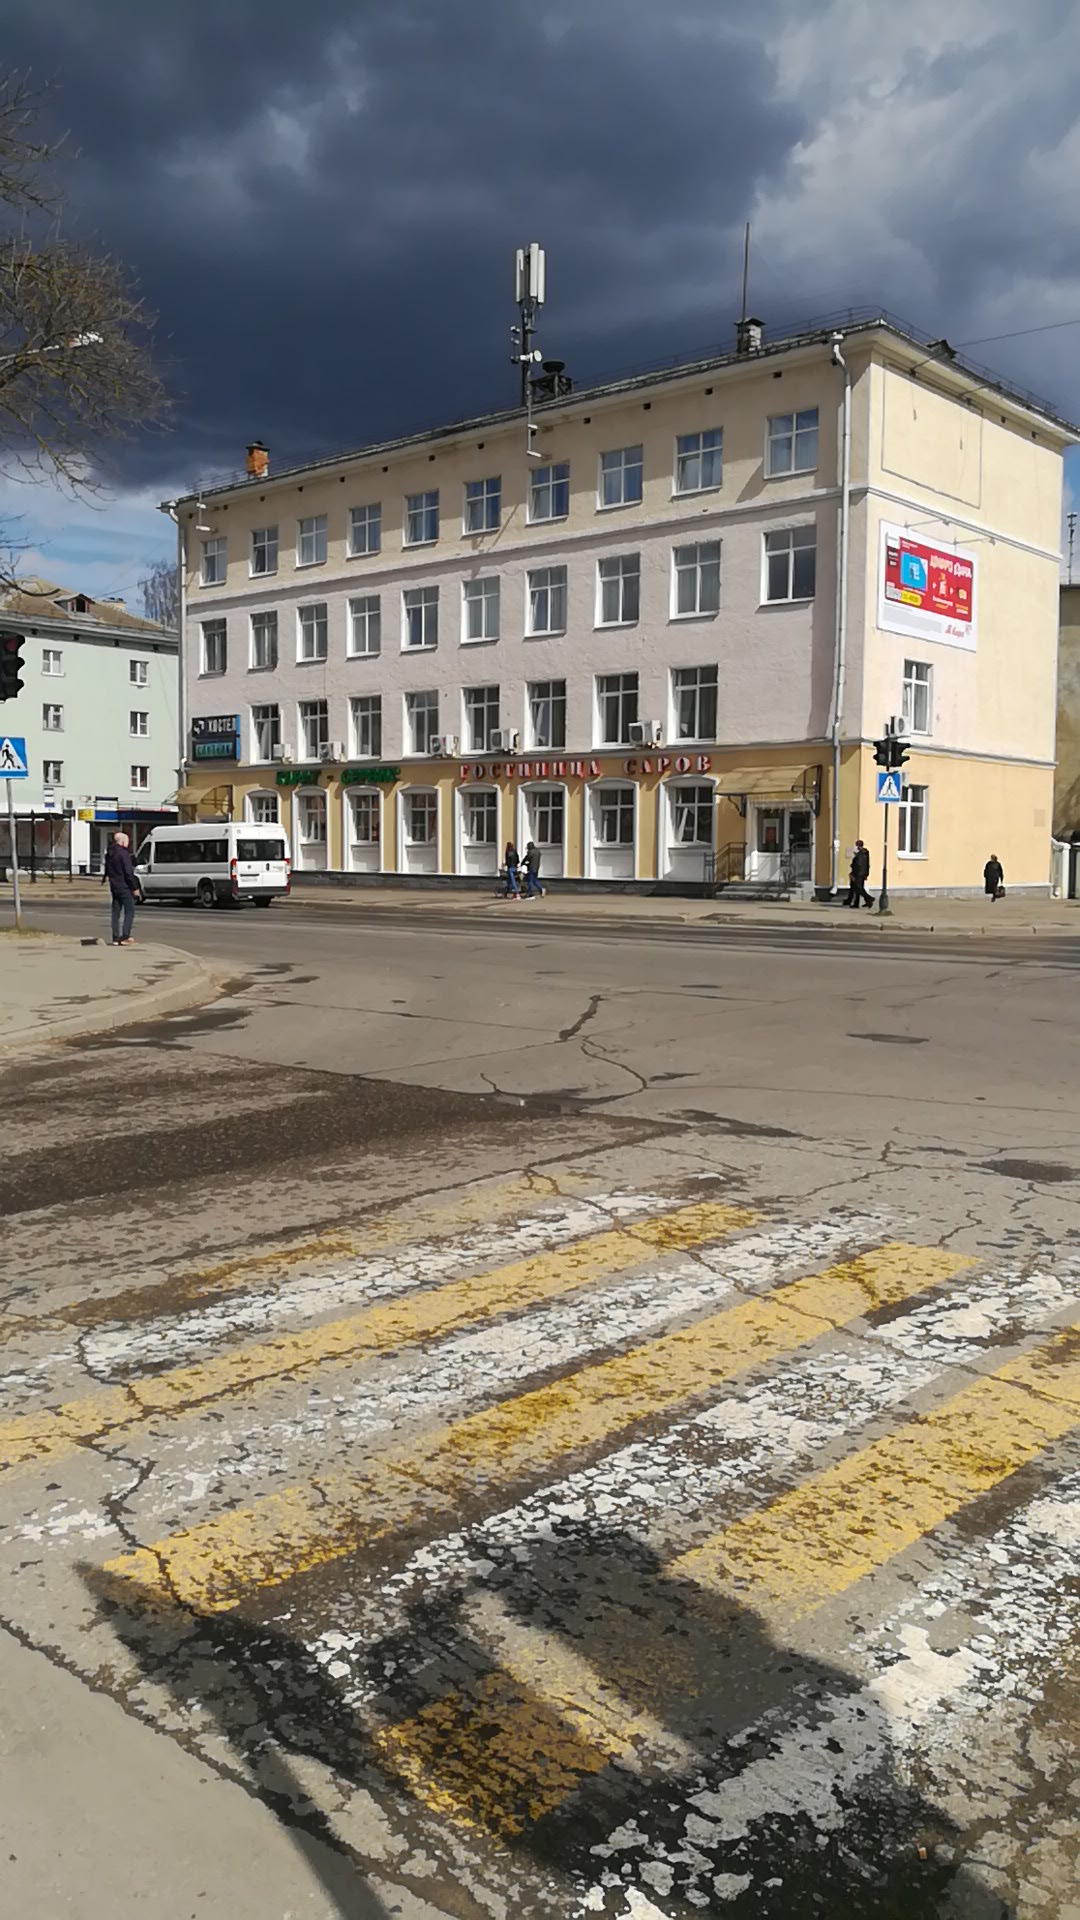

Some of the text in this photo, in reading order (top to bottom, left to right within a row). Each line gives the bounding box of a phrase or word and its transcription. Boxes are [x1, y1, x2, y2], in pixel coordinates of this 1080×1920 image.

[208, 717, 236, 732] ХОСТЕЛ
[460, 755, 711, 780] ГОСТИНИЦА САРОВ
